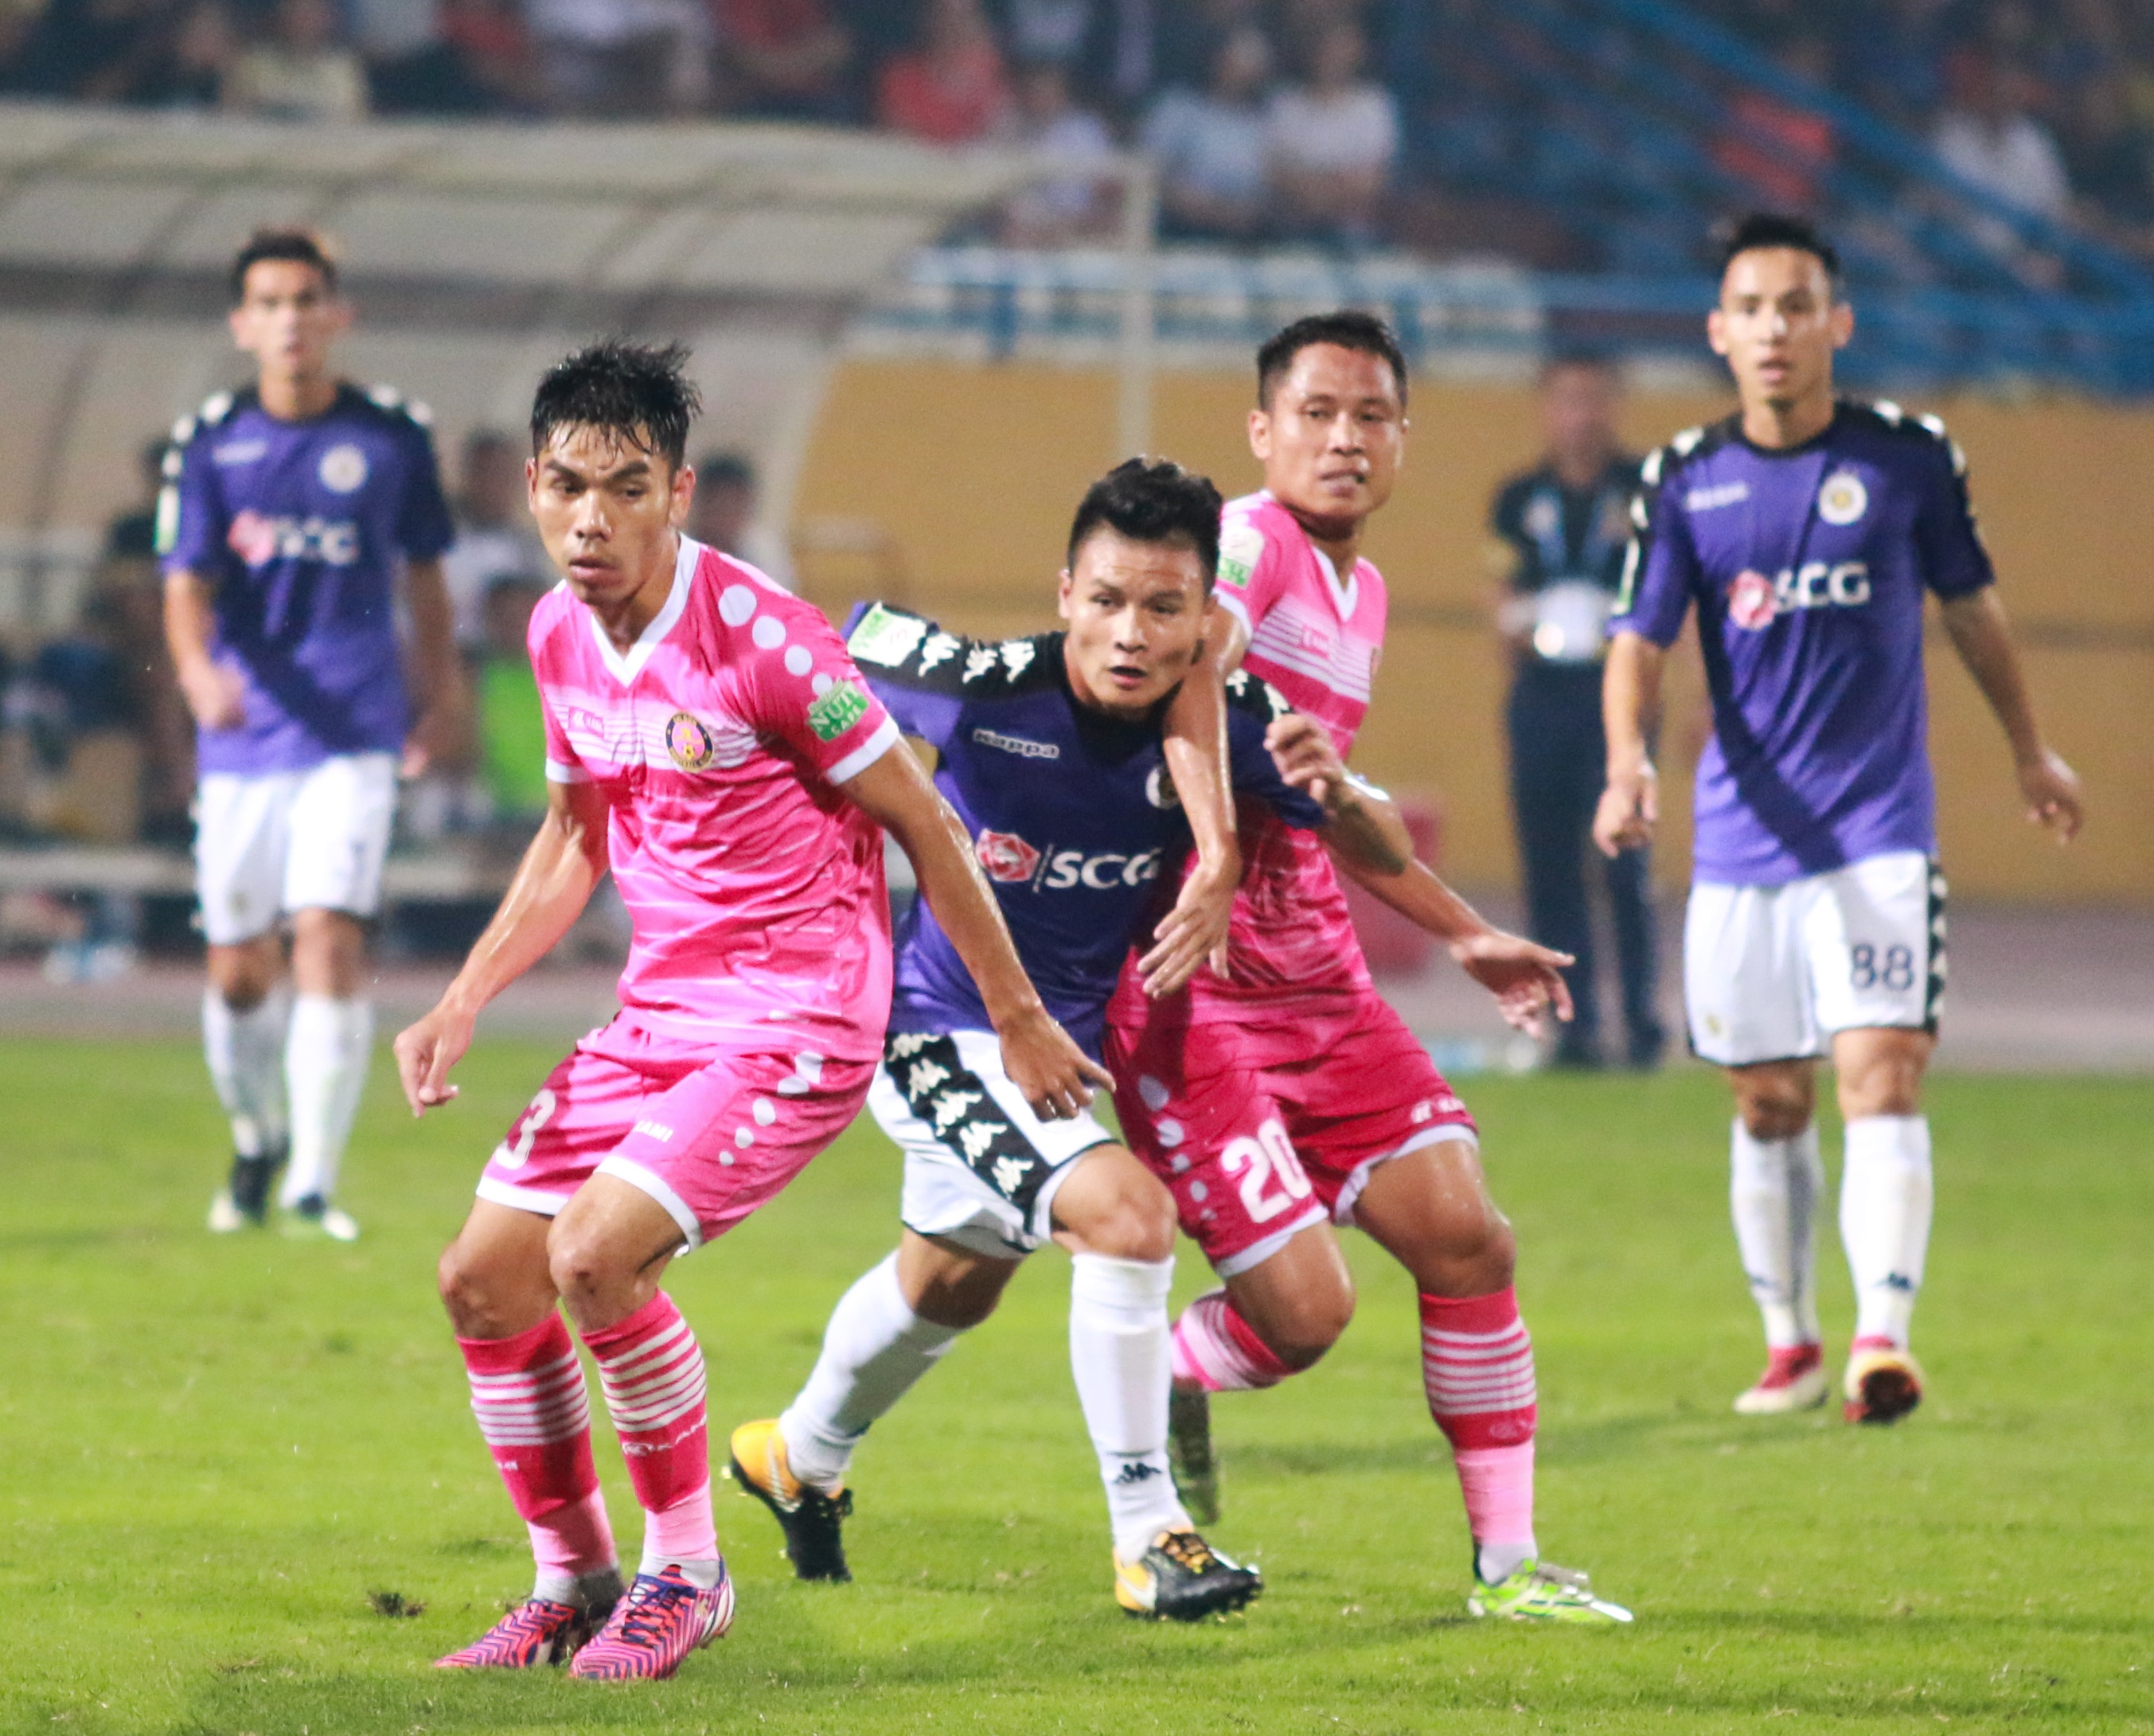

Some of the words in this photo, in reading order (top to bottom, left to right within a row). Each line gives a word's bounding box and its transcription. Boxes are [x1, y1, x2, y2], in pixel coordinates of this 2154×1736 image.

[1776, 560, 1871, 613] SCG
[1044, 848, 1163, 889] SCG
[1851, 944, 1914, 990] 88
[493, 1089, 556, 1170] 3
[1220, 1118, 1312, 1224] 20
